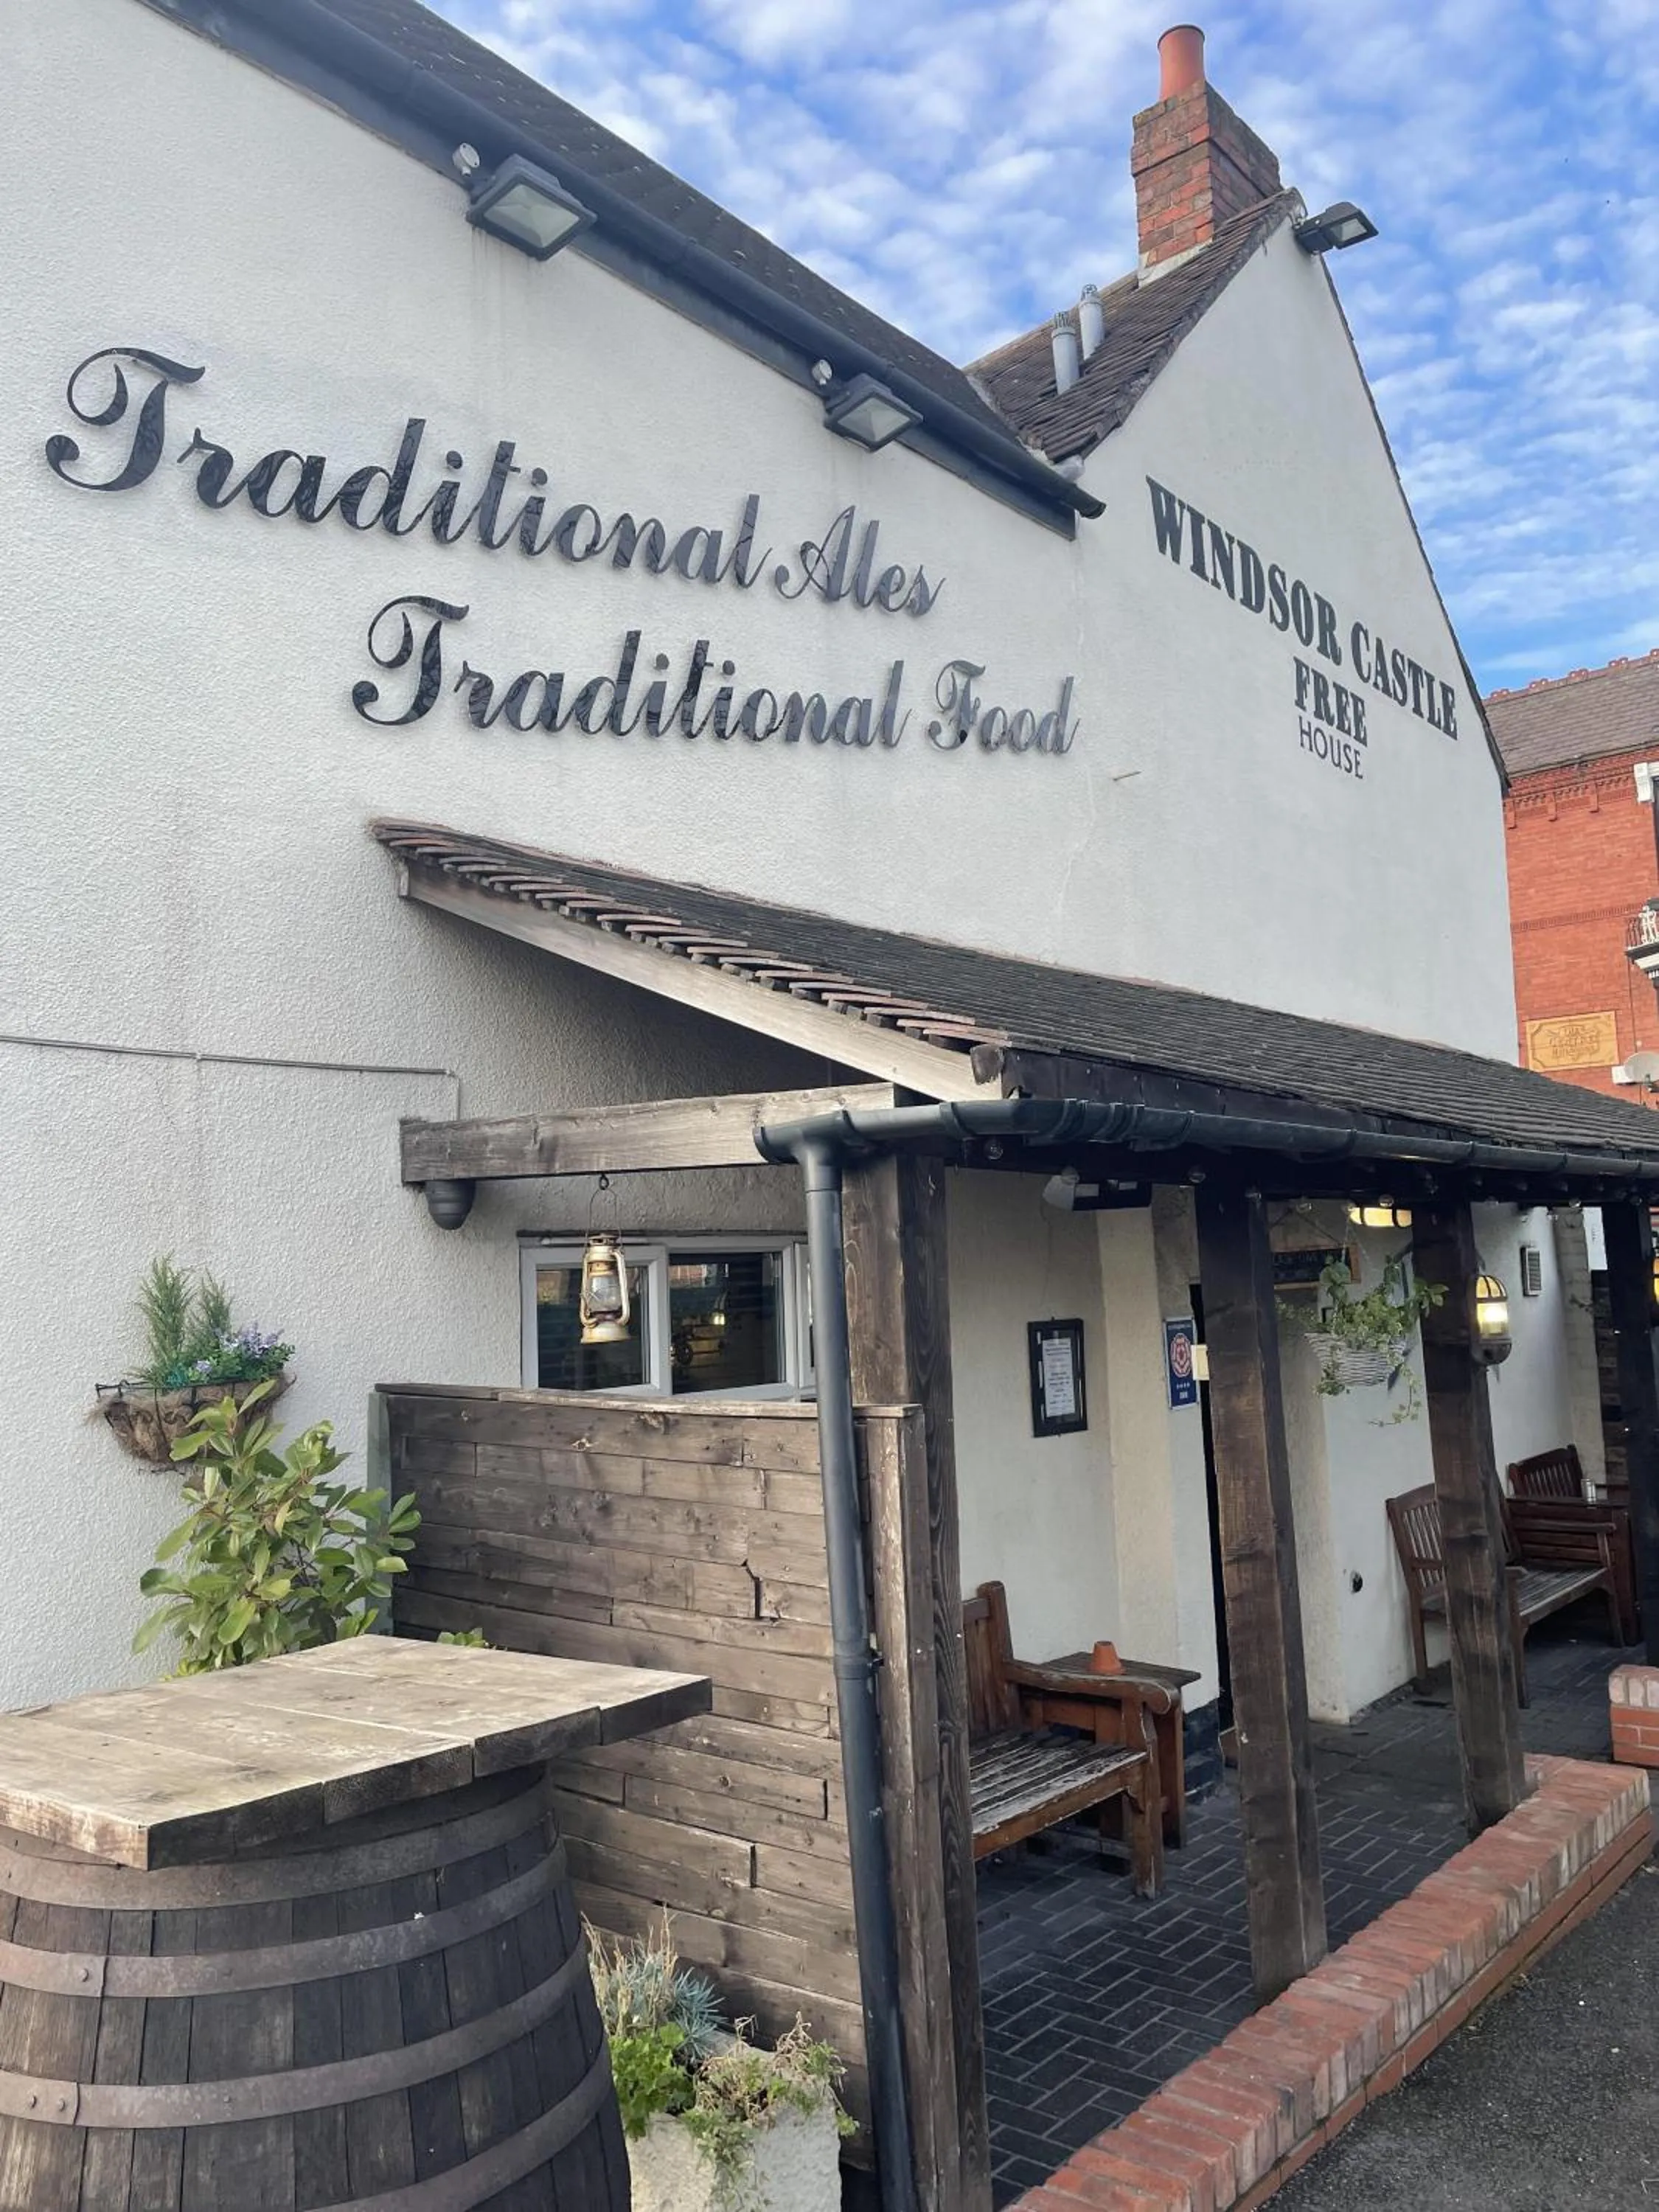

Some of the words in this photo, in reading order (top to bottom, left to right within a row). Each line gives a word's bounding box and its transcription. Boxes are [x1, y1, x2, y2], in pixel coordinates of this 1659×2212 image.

[45, 347, 772, 588] Traditional
[775, 504, 946, 616] Ales
[352, 595, 912, 747] Traditional
[928, 659, 1079, 754] Food
[1145, 474, 1343, 666] WINDSOR
[1352, 622, 1458, 740] CASTLE
[1293, 655, 1368, 747] FREE
[1298, 715, 1363, 779] HOUSE
